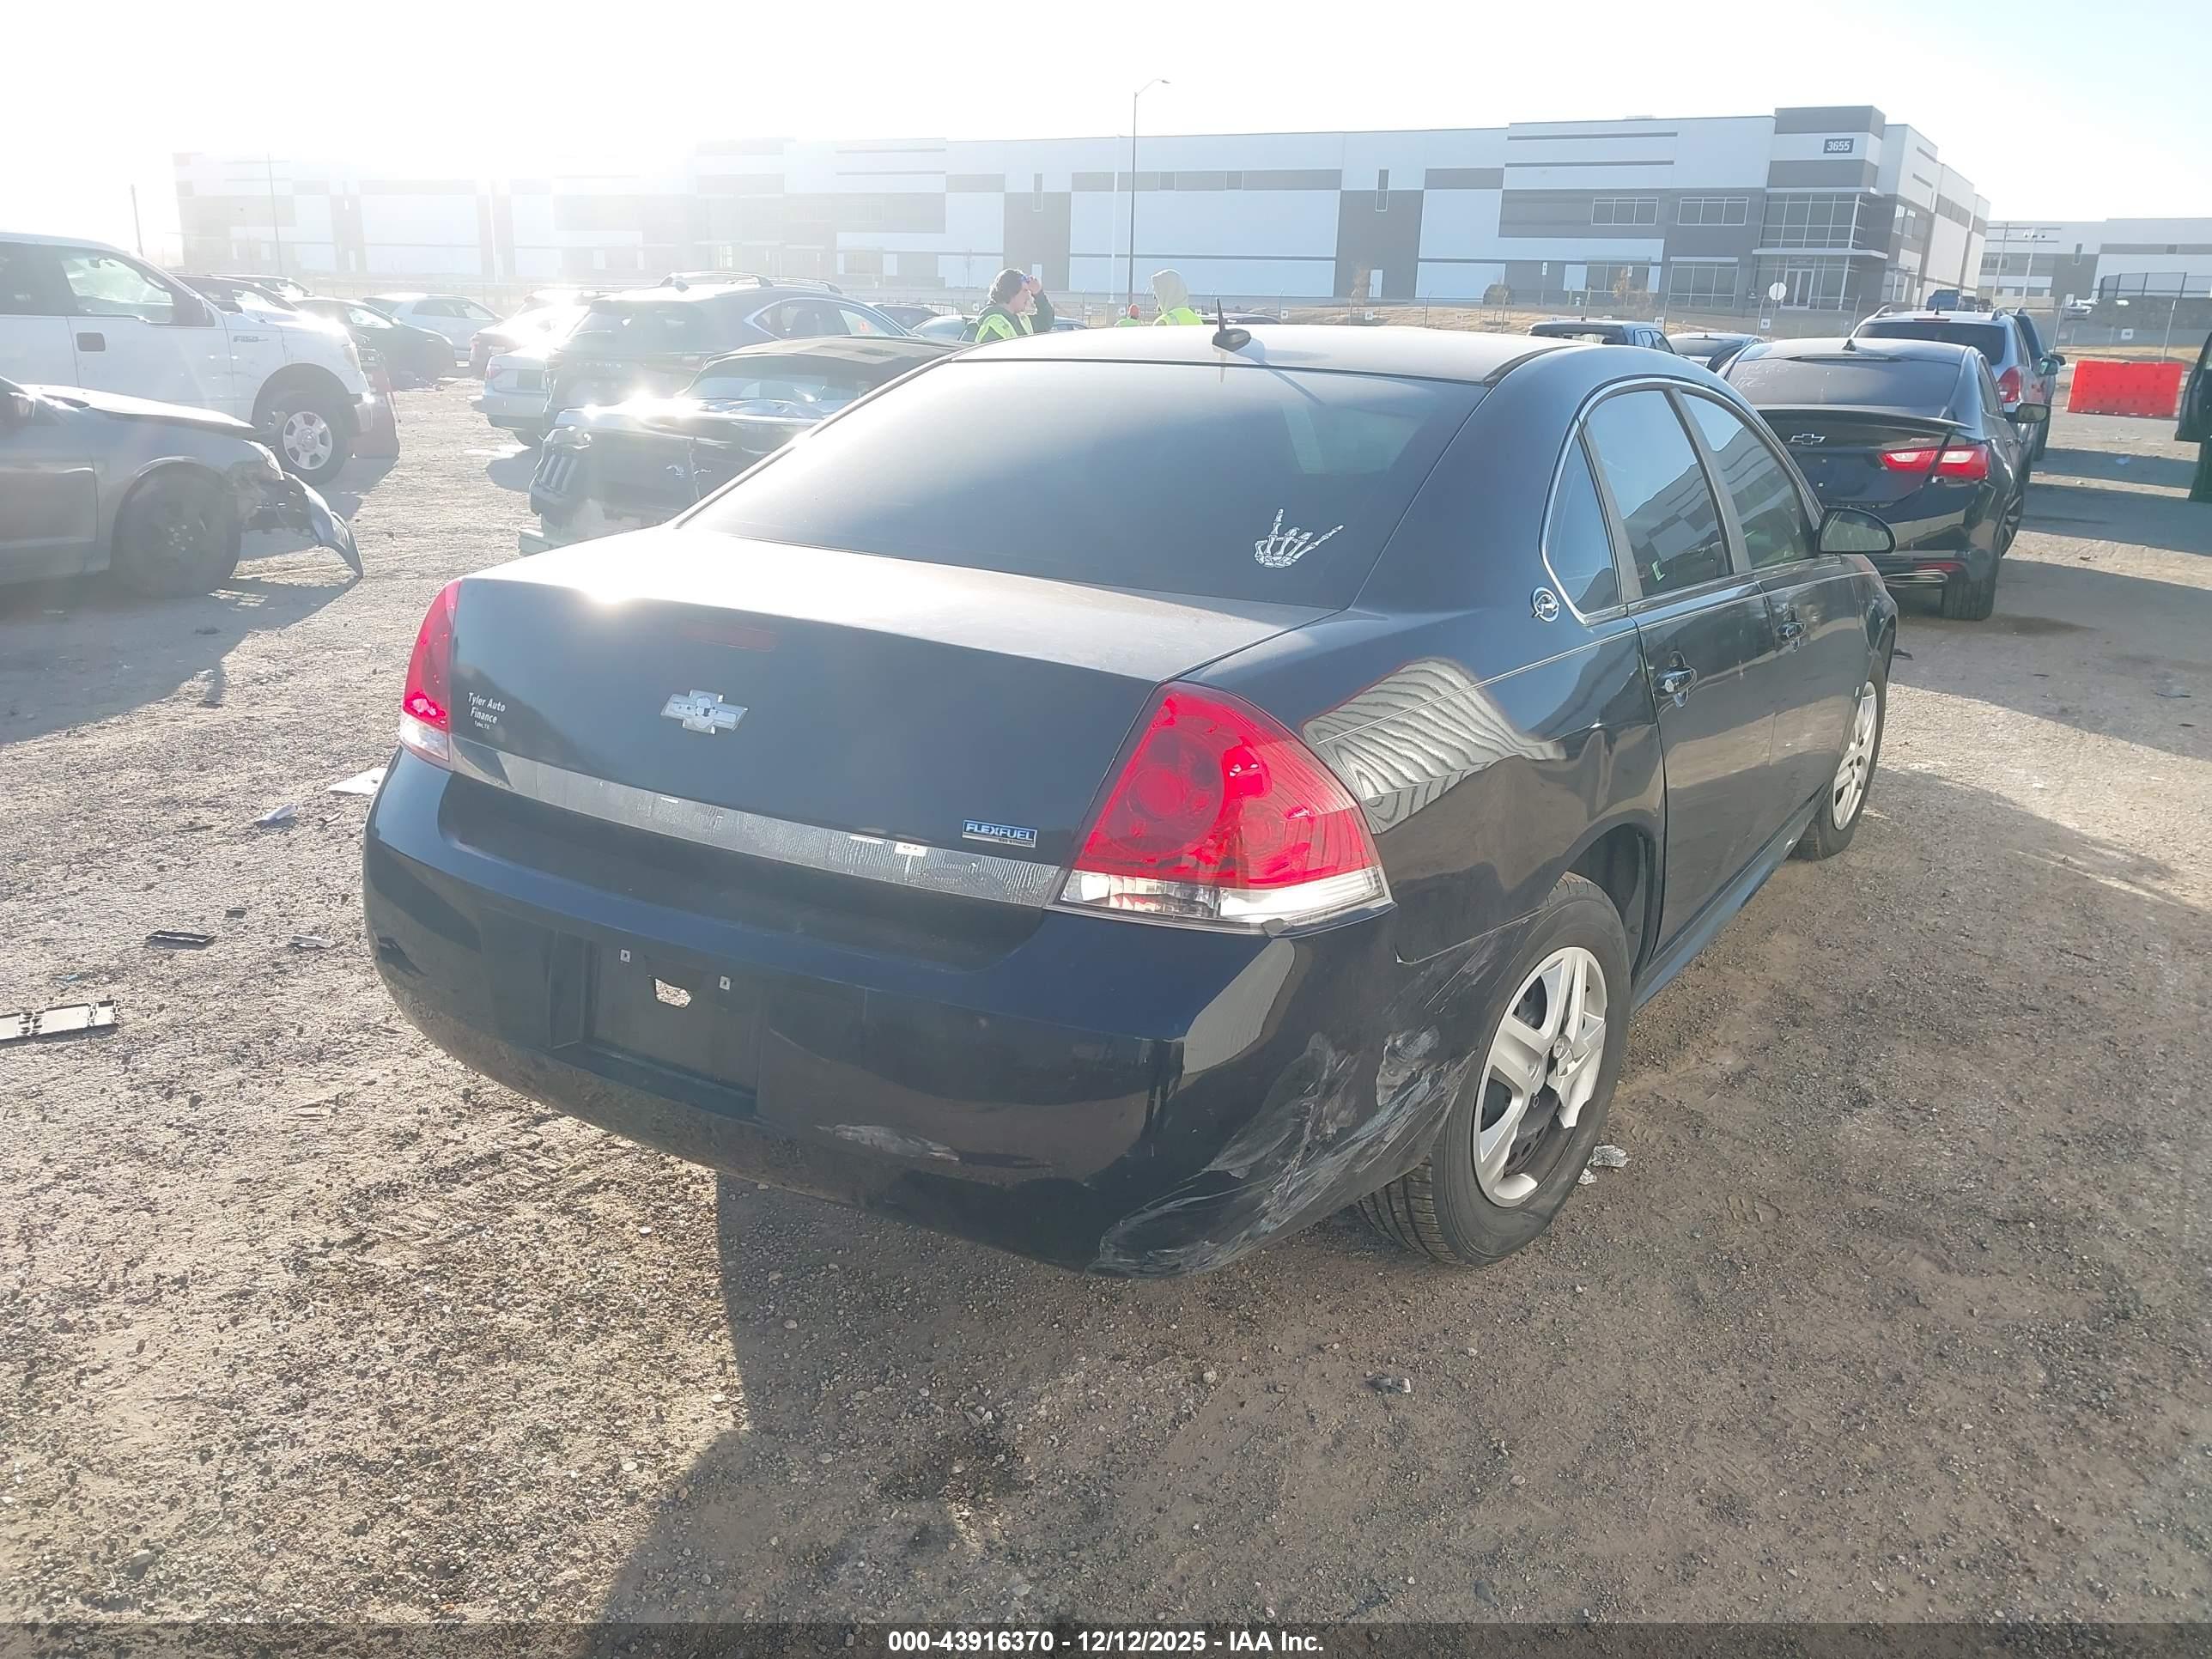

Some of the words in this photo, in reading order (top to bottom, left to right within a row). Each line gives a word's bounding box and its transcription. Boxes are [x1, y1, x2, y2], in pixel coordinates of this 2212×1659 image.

[1826, 140, 1850, 151] 3655
[468, 692, 487, 707] Tyler
[487, 698, 506, 713] Auto
[470, 706, 498, 724] Finance
[965, 822, 1033, 841] FLEXFUEL
